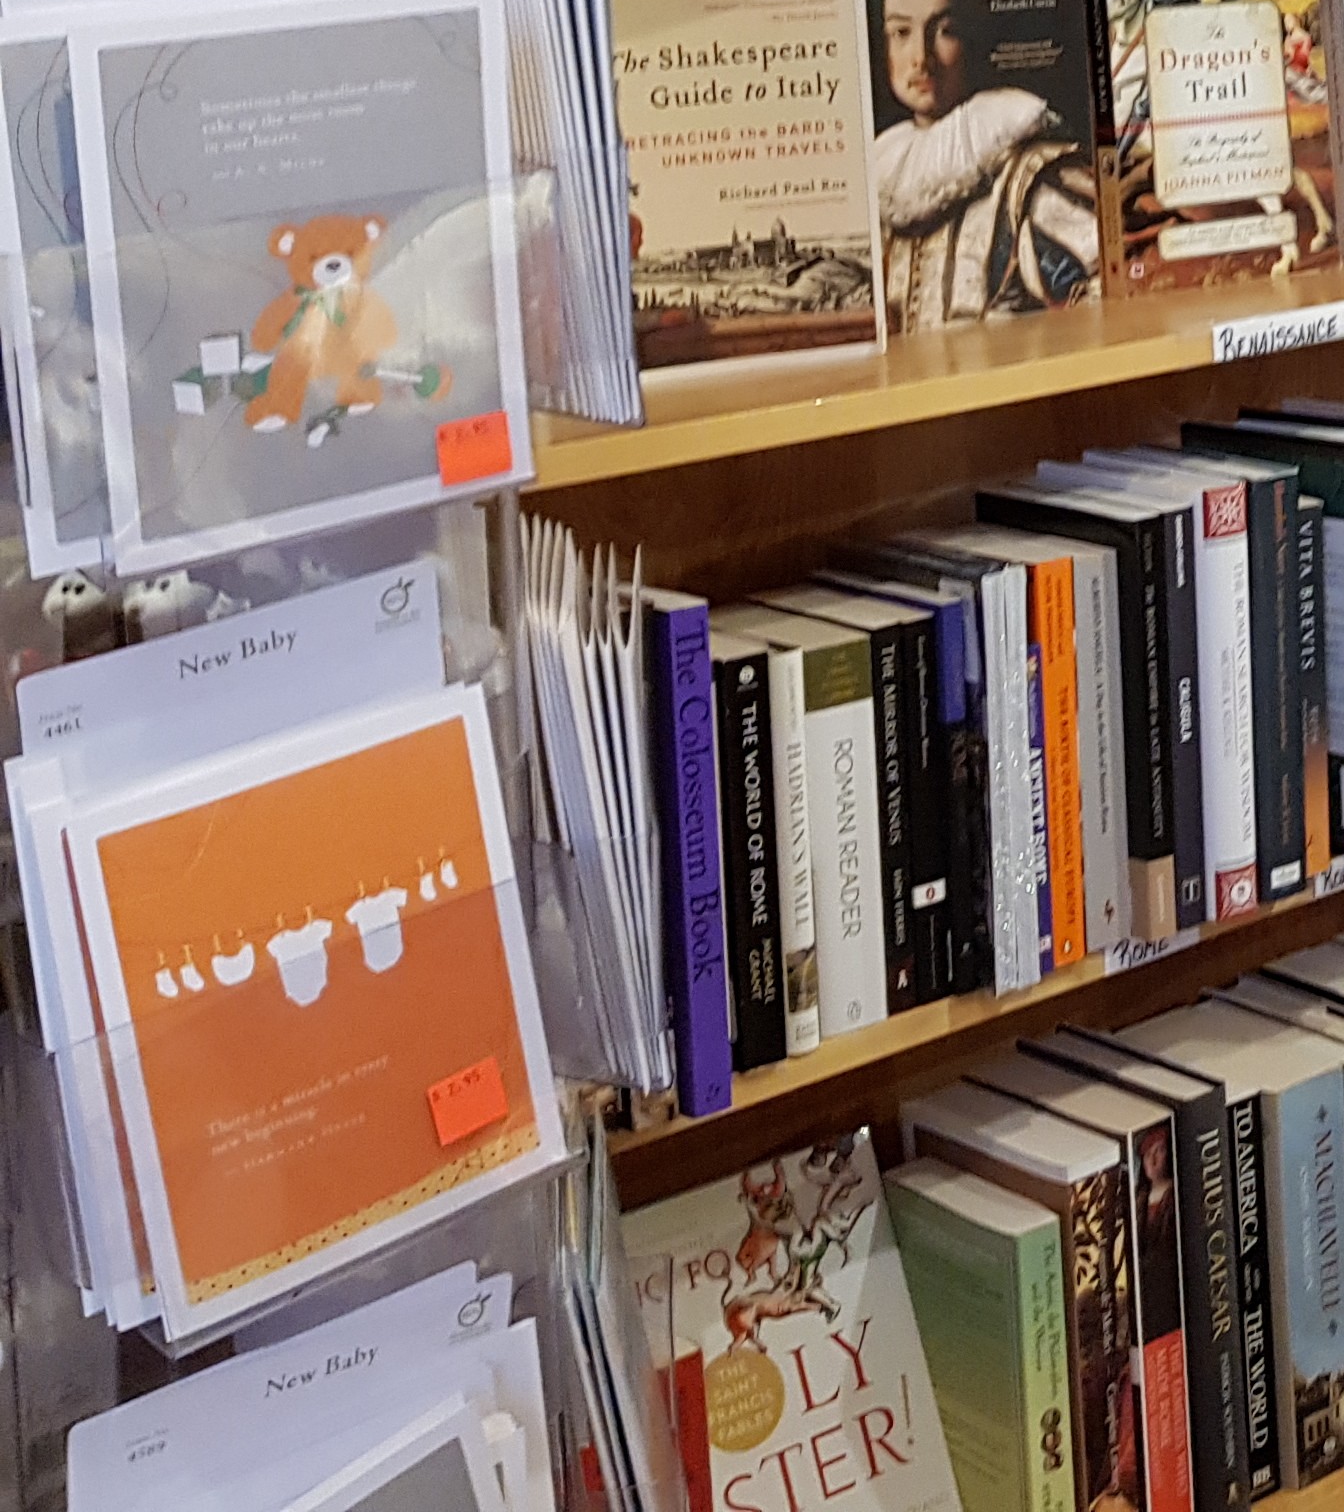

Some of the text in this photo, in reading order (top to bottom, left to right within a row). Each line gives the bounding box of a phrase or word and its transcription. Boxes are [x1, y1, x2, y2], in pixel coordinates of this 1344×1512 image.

[659, 40, 838, 73] Shakespeare
[1158, 40, 1271, 73] Dragon's
[650, 73, 840, 110] Guide to Italy
[1185, 71, 1248, 103] Trail
[625, 120, 844, 152] RETRACING the BARD'S
[662, 141, 845, 169] UNKNOWN TRAVELS
[719, 185, 777, 202] Richard
[784, 181, 815, 197] Paul
[1163, 166, 1284, 193] JOANNA PITMAN
[1220, 315, 1337, 362] RENAISSANCE
[1299, 519, 1317, 671] VITA BREVIS
[179, 629, 298, 679] New Baby
[880, 643, 897, 680] THE
[886, 760, 901, 782] OF
[676, 622, 722, 985] The Colosseum Book
[742, 700, 769, 927] THE WORLD OF ROME
[787, 742, 812, 927] HADRIAN'S WALL
[833, 737, 862, 940] ROMAN READER
[750, 949, 762, 1000] GRANT
[762, 937, 775, 1005] MICHAEL
[1113, 937, 1170, 969] ROME
[1234, 1104, 1259, 1257] TO AMERICA
[1196, 1128, 1233, 1343] JULIUS CAESAR
[1314, 1129, 1342, 1311] MACHIAVELLI
[264, 1344, 379, 1398] New Baby
[1244, 1307, 1269, 1451] THE WORLD
